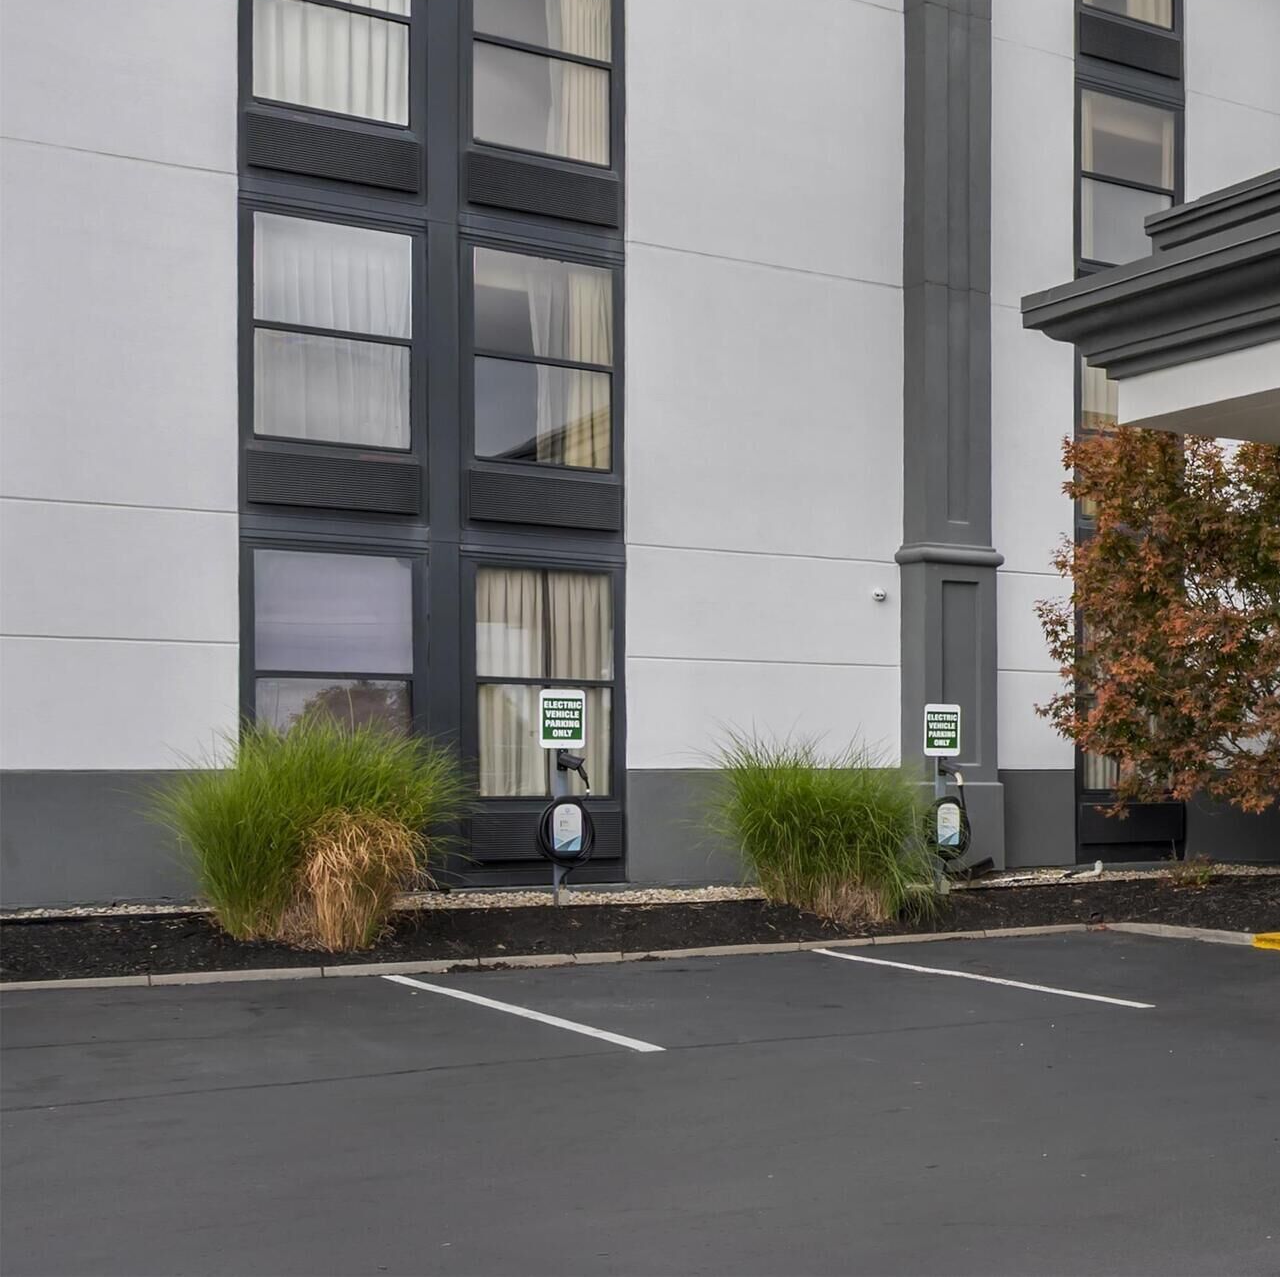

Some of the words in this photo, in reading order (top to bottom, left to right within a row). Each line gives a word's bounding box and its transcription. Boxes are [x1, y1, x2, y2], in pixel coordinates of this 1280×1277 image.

[544, 700, 582, 709] ELECTRIC
[545, 710, 580, 718] VEHICLE
[545, 720, 580, 728] PARKING
[552, 729, 573, 737] ONLY
